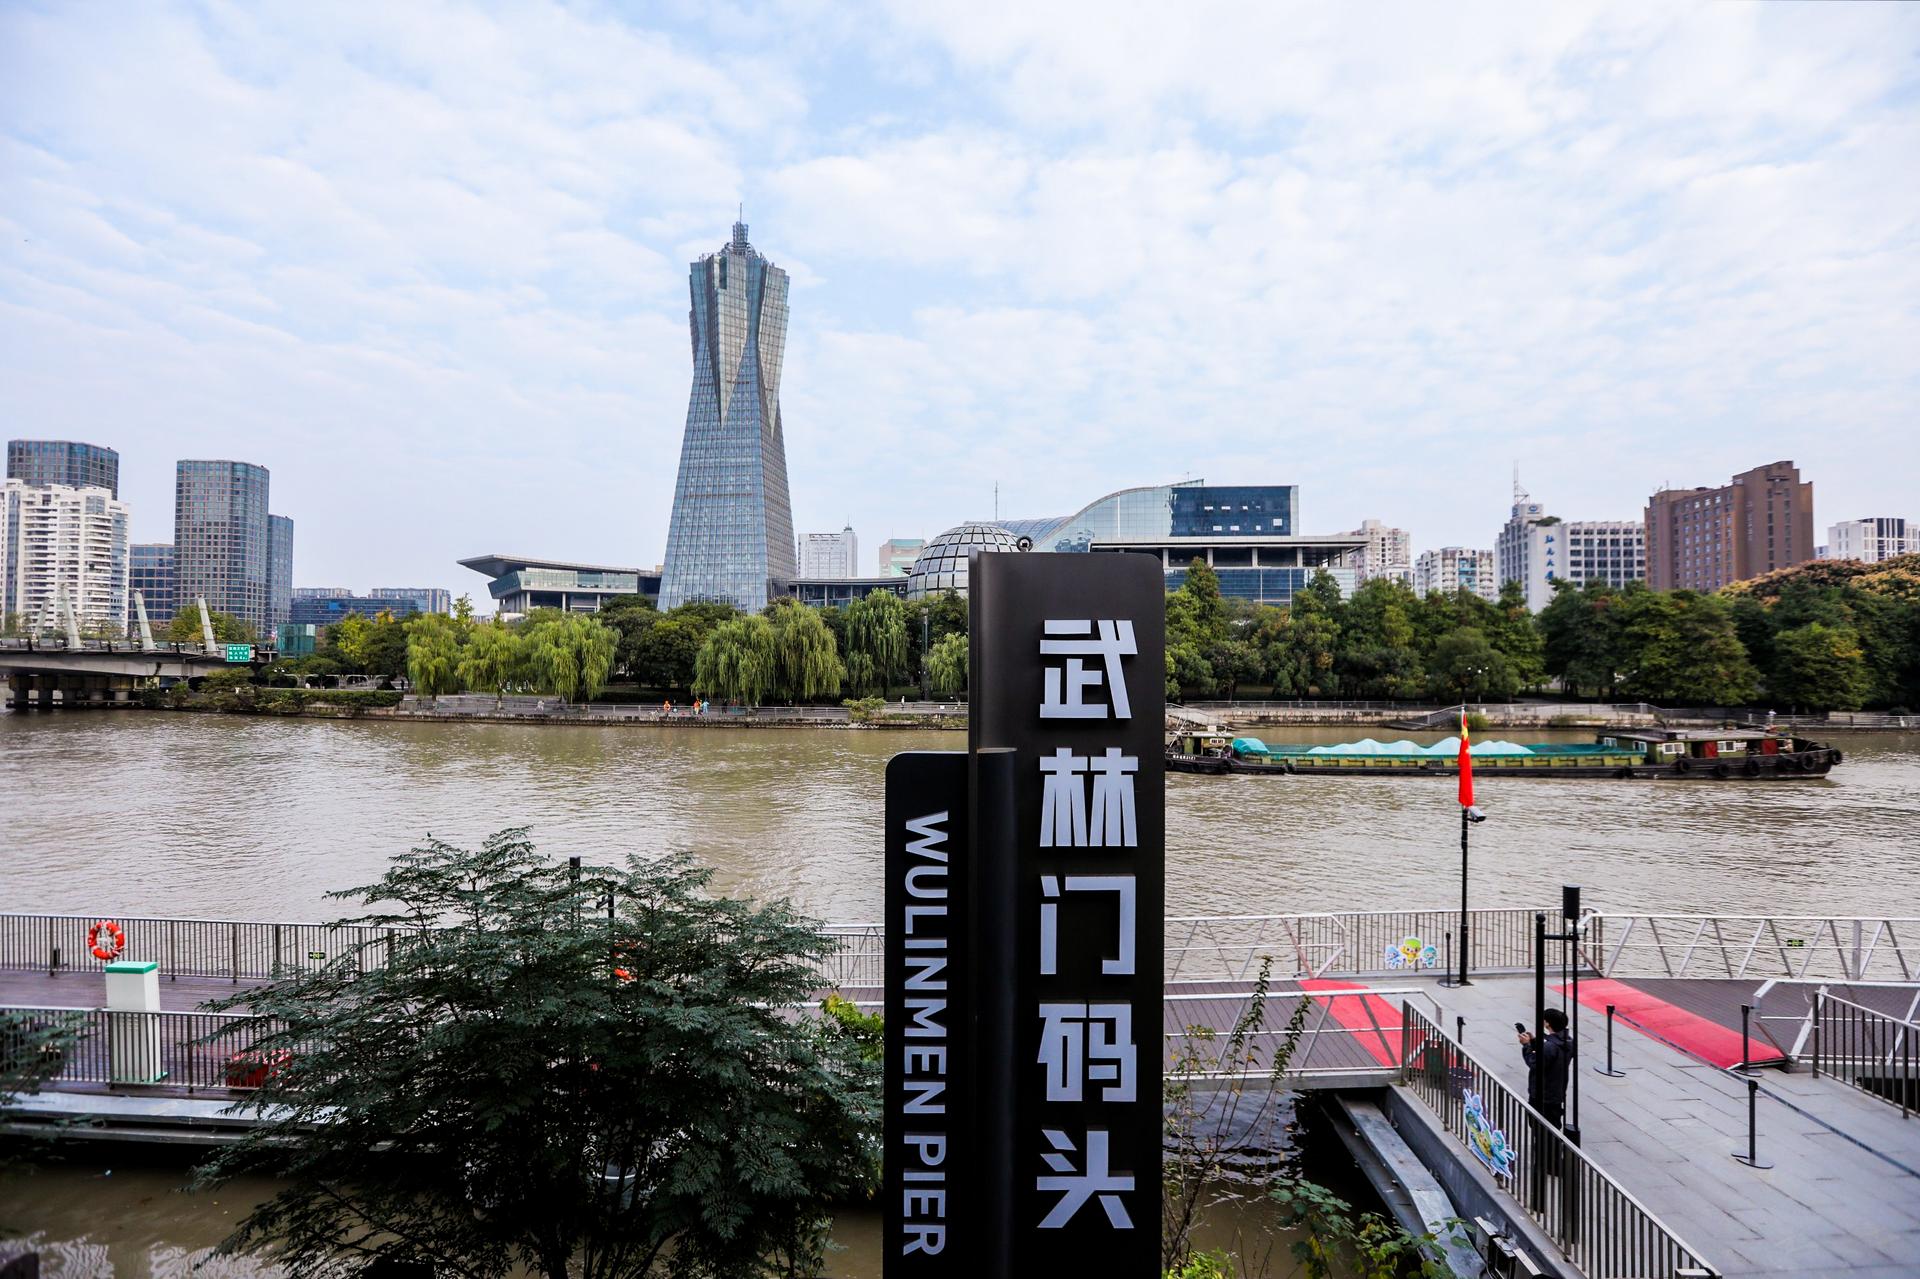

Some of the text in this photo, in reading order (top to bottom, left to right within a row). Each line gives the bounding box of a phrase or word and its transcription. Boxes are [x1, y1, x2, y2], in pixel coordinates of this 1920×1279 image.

[903, 811, 949, 1256] WULINMEN PIER
[1037, 619, 1139, 1229] 武林门码头
